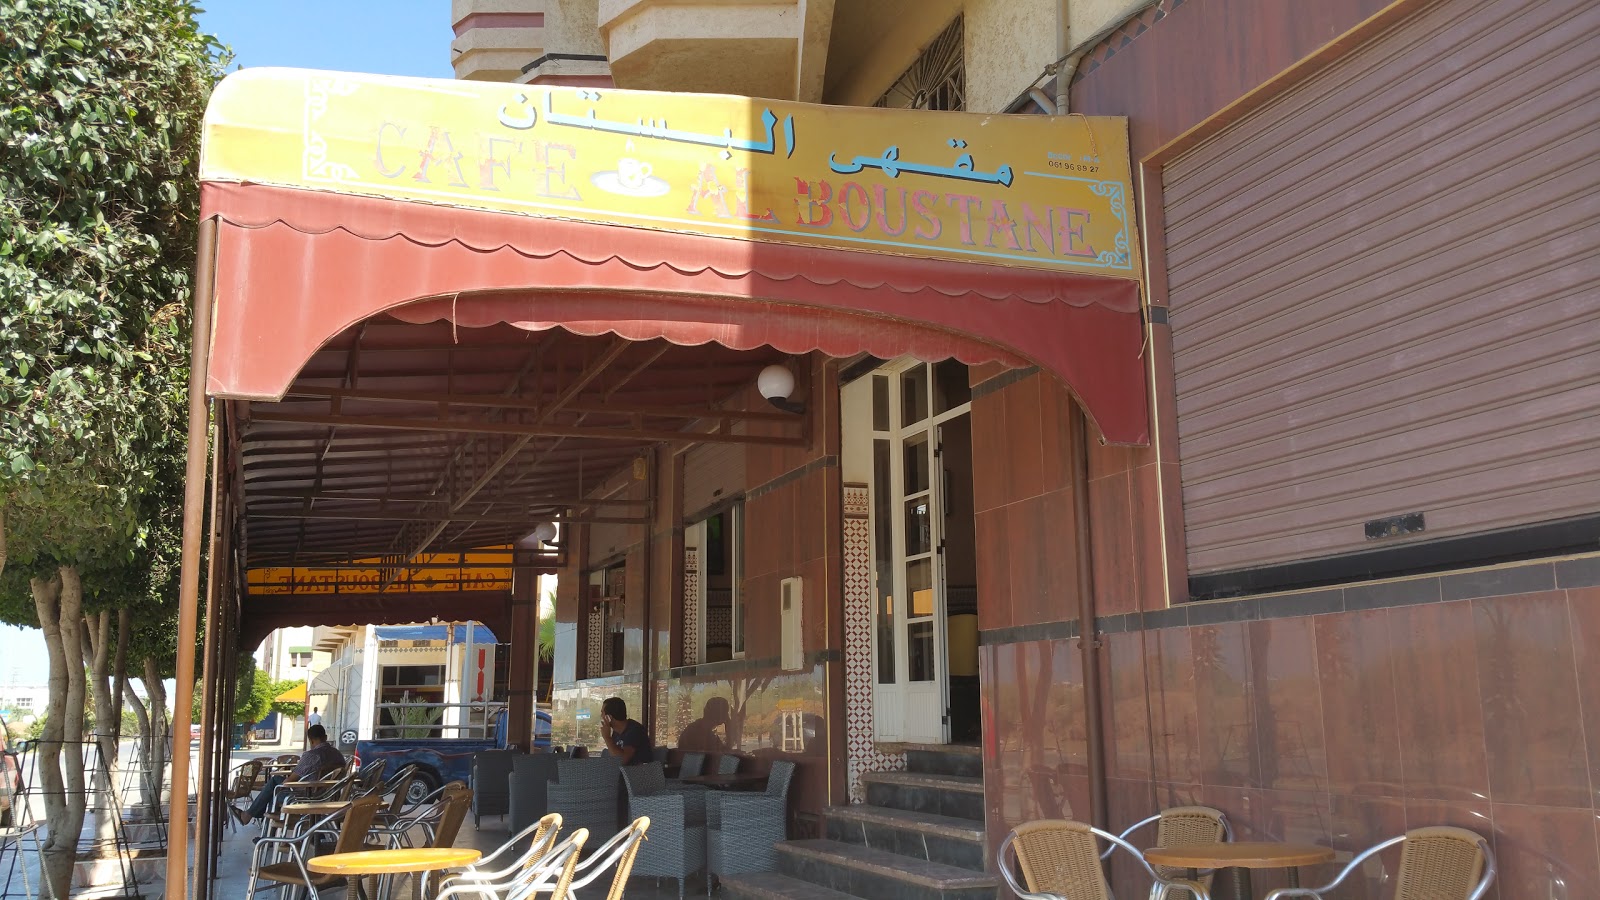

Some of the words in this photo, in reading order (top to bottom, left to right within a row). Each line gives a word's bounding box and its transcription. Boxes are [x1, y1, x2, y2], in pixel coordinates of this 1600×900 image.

[497, 90, 796, 160] البستان
[374, 120, 584, 202] CAFE
[685, 163, 781, 225] AL
[793, 176, 1098, 259] BOUSTANE
[829, 138, 1015, 188] مقهى
[1048, 160, 1063, 169] 061
[1064, 162, 1075, 171] 96
[1089, 165, 1099, 173] 27
